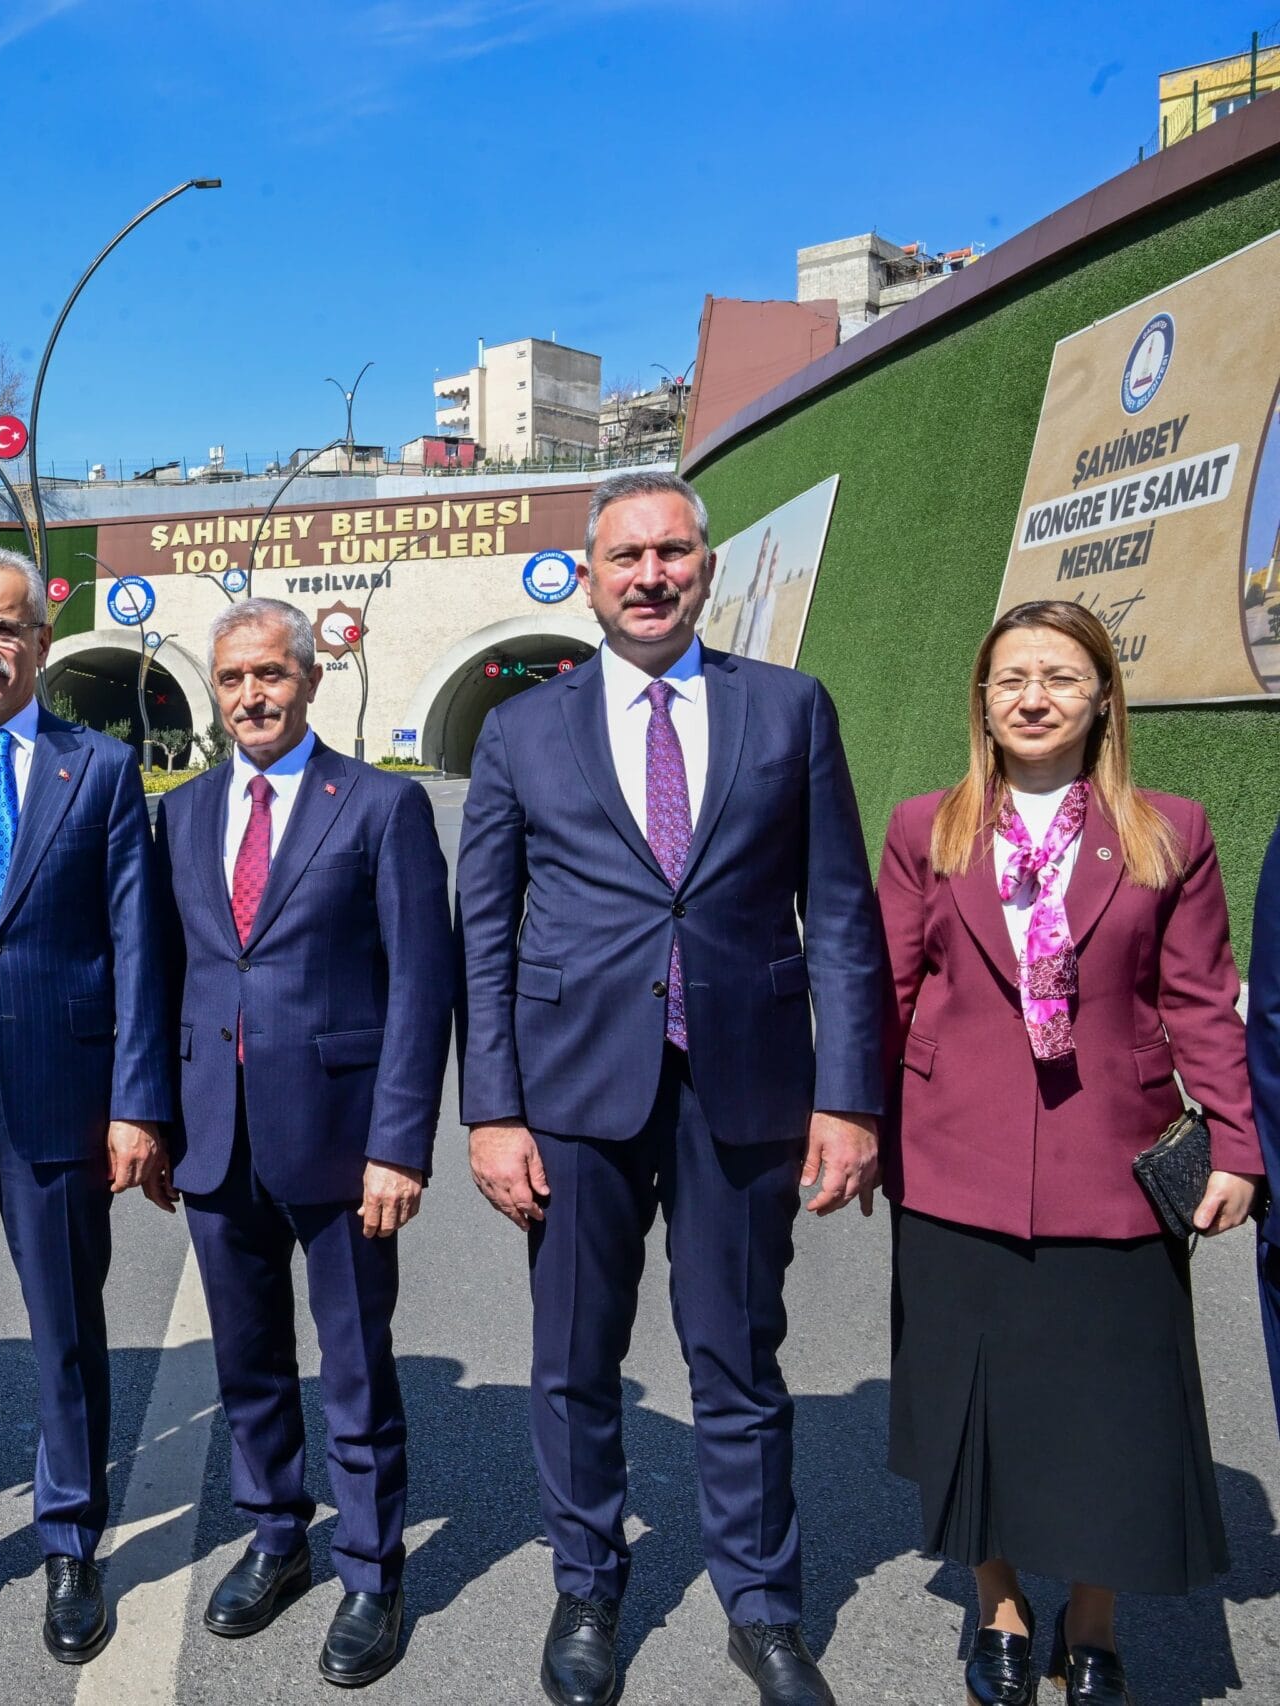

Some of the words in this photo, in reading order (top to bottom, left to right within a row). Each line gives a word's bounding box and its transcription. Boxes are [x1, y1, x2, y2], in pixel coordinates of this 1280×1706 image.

[1072, 414, 1190, 489] ŞAHİNBEY
[150, 515, 314, 551] ŞAHİNBEY
[331, 495, 530, 537] BELEDİYESİ
[1024, 491, 1107, 544] KONGRE
[1109, 481, 1141, 522] VE
[1139, 454, 1230, 514] SANAT
[172, 548, 239, 574] 100.
[250, 544, 301, 569] YIL
[318, 526, 505, 565] TÜNELLERİ
[1056, 520, 1156, 582] MERKEZİ
[285, 569, 391, 594] YEŞİLVADİ
[326, 662, 349, 671] 2024
